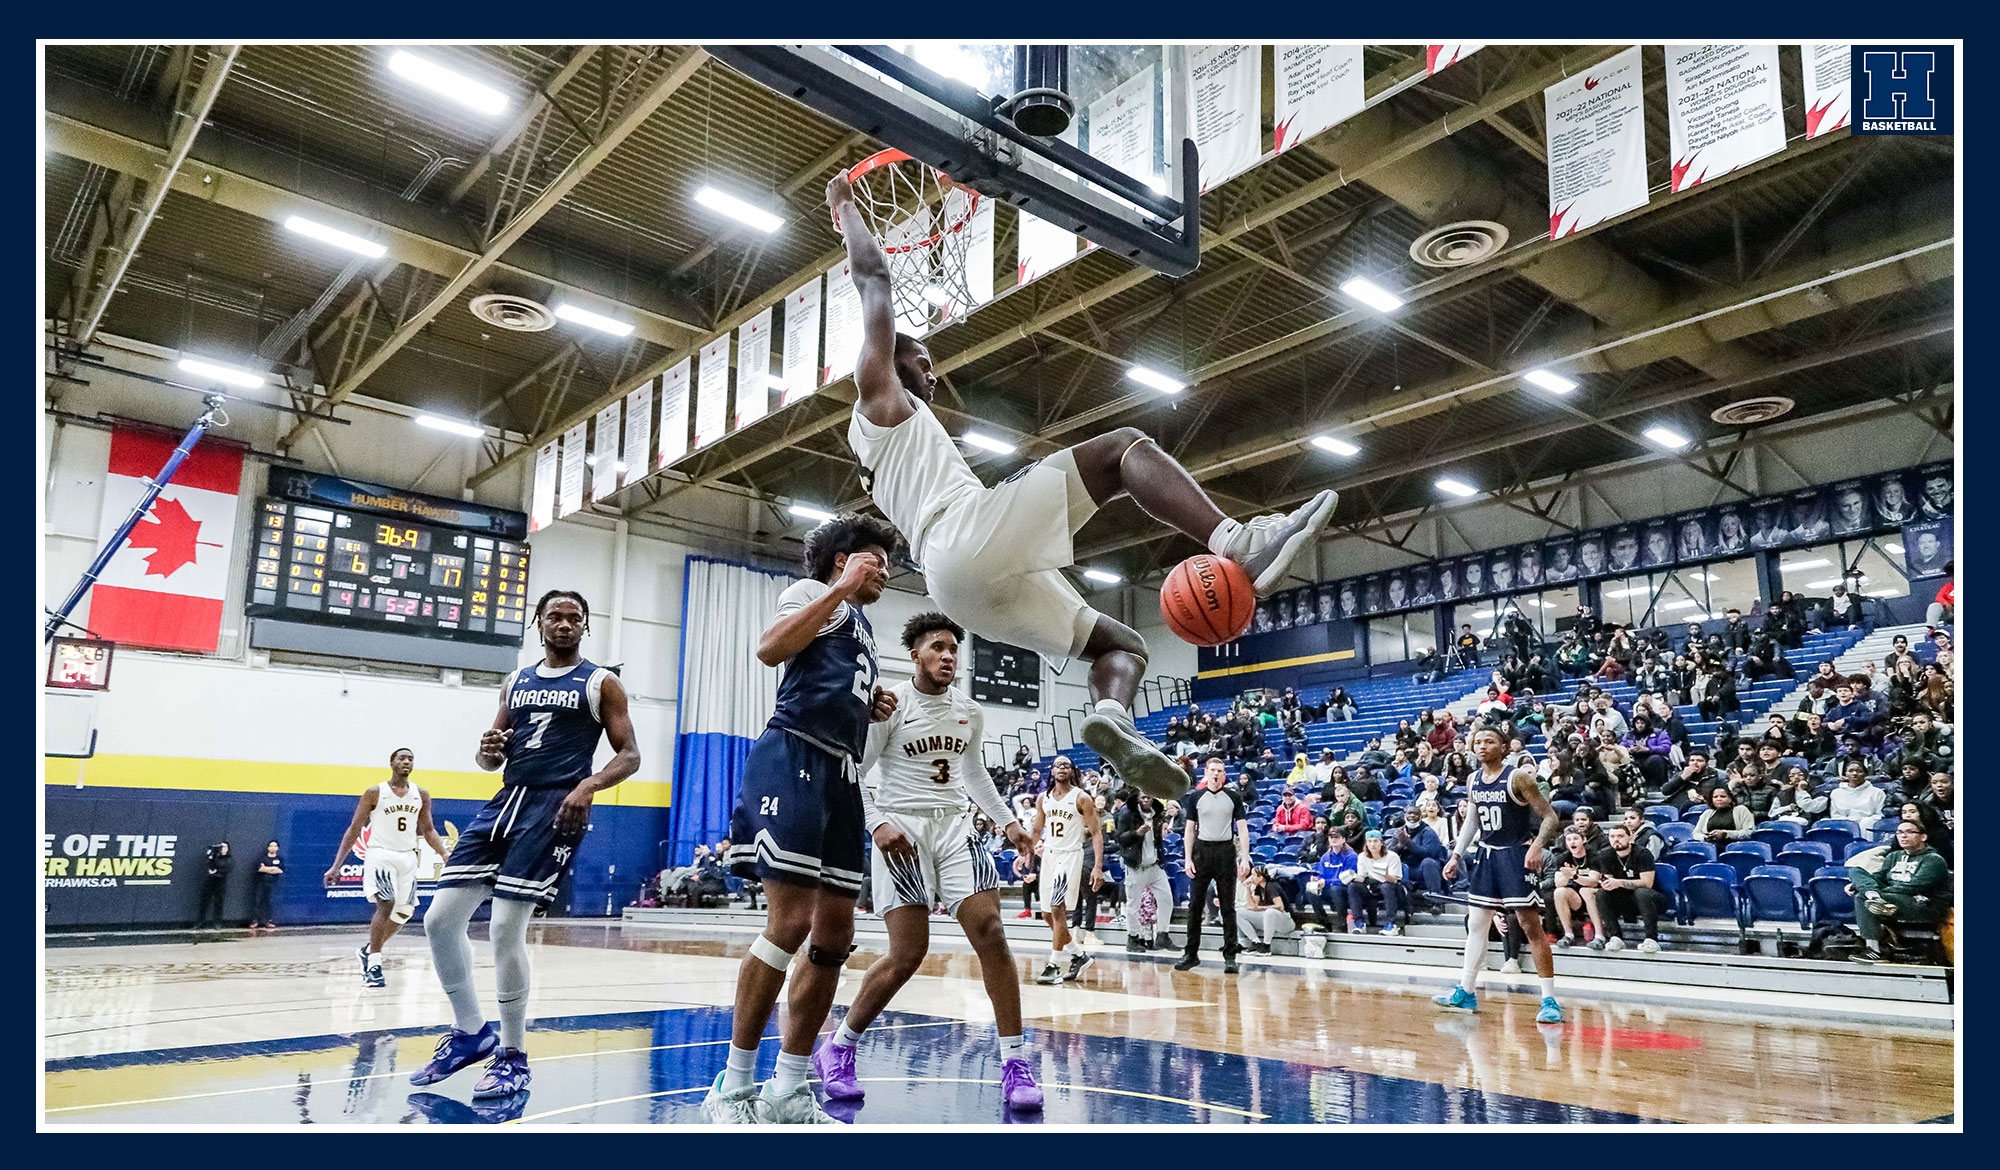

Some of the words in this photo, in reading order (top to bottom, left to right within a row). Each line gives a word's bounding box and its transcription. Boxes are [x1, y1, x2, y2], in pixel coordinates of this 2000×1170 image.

[1207, 59, 1238, 79] CHAMPIONS
[1283, 52, 1317, 72] BADMINTON
[1678, 56, 1720, 76] BADMINTON
[1288, 68, 1306, 80] Adam
[1716, 63, 1768, 89] NATIONAL
[1723, 75, 1756, 92] DOUBLES
[1555, 102, 1587, 120] 2021-22
[1588, 82, 1632, 106] NATIONAL
[1680, 95, 1722, 117] BADMINTON
[1723, 77, 1767, 98] CHAMPIONS
[1565, 108, 1584, 122] MEN'S
[1584, 95, 1621, 114] BASKETBALL
[1575, 105, 1612, 123] CHAMPIONS
[1686, 109, 1714, 123] Victoria
[1714, 99, 1740, 113] Duong
[1687, 126, 1709, 138] Karen
[1710, 121, 1721, 130] Ng
[1743, 103, 1767, 115] Coach
[1688, 133, 1709, 145] David
[351, 492, 408, 513] HUMBER
[271, 531, 281, 542] 3
[258, 561, 278, 572] 23
[314, 553, 325, 564] 0
[351, 554, 366, 574] 6
[518, 557, 527, 567] 2
[261, 577, 276, 587] 12
[480, 565, 490, 576] 3
[499, 567, 508, 578] 0
[518, 571, 526, 581] 3
[311, 583, 322, 594] 0
[480, 579, 488, 588] 4
[498, 581, 508, 592] 0
[516, 584, 525, 594] 0
[1193, 557, 1220, 611] Wilson
[340, 592, 352, 606] 4
[471, 591, 487, 602] 20
[497, 594, 506, 605] 0
[515, 597, 524, 608] 0
[422, 604, 432, 615] 2
[448, 606, 459, 620] 3
[470, 605, 486, 616] 24
[496, 608, 505, 619] 0
[851, 652, 877, 706] 2
[510, 689, 580, 710] NIAGARA
[524, 712, 553, 749] 7
[930, 758, 951, 785] 3
[760, 795, 779, 816] 24
[1472, 790, 1507, 803] NIAGARA
[397, 816, 407, 832] 6
[1046, 809, 1074, 821] UMBER
[1478, 805, 1503, 831] 20
[1050, 821, 1064, 837] 12
[62, 833, 110, 857] OF
[116, 835, 177, 857] THE
[75, 857, 173, 876] HAWKS
